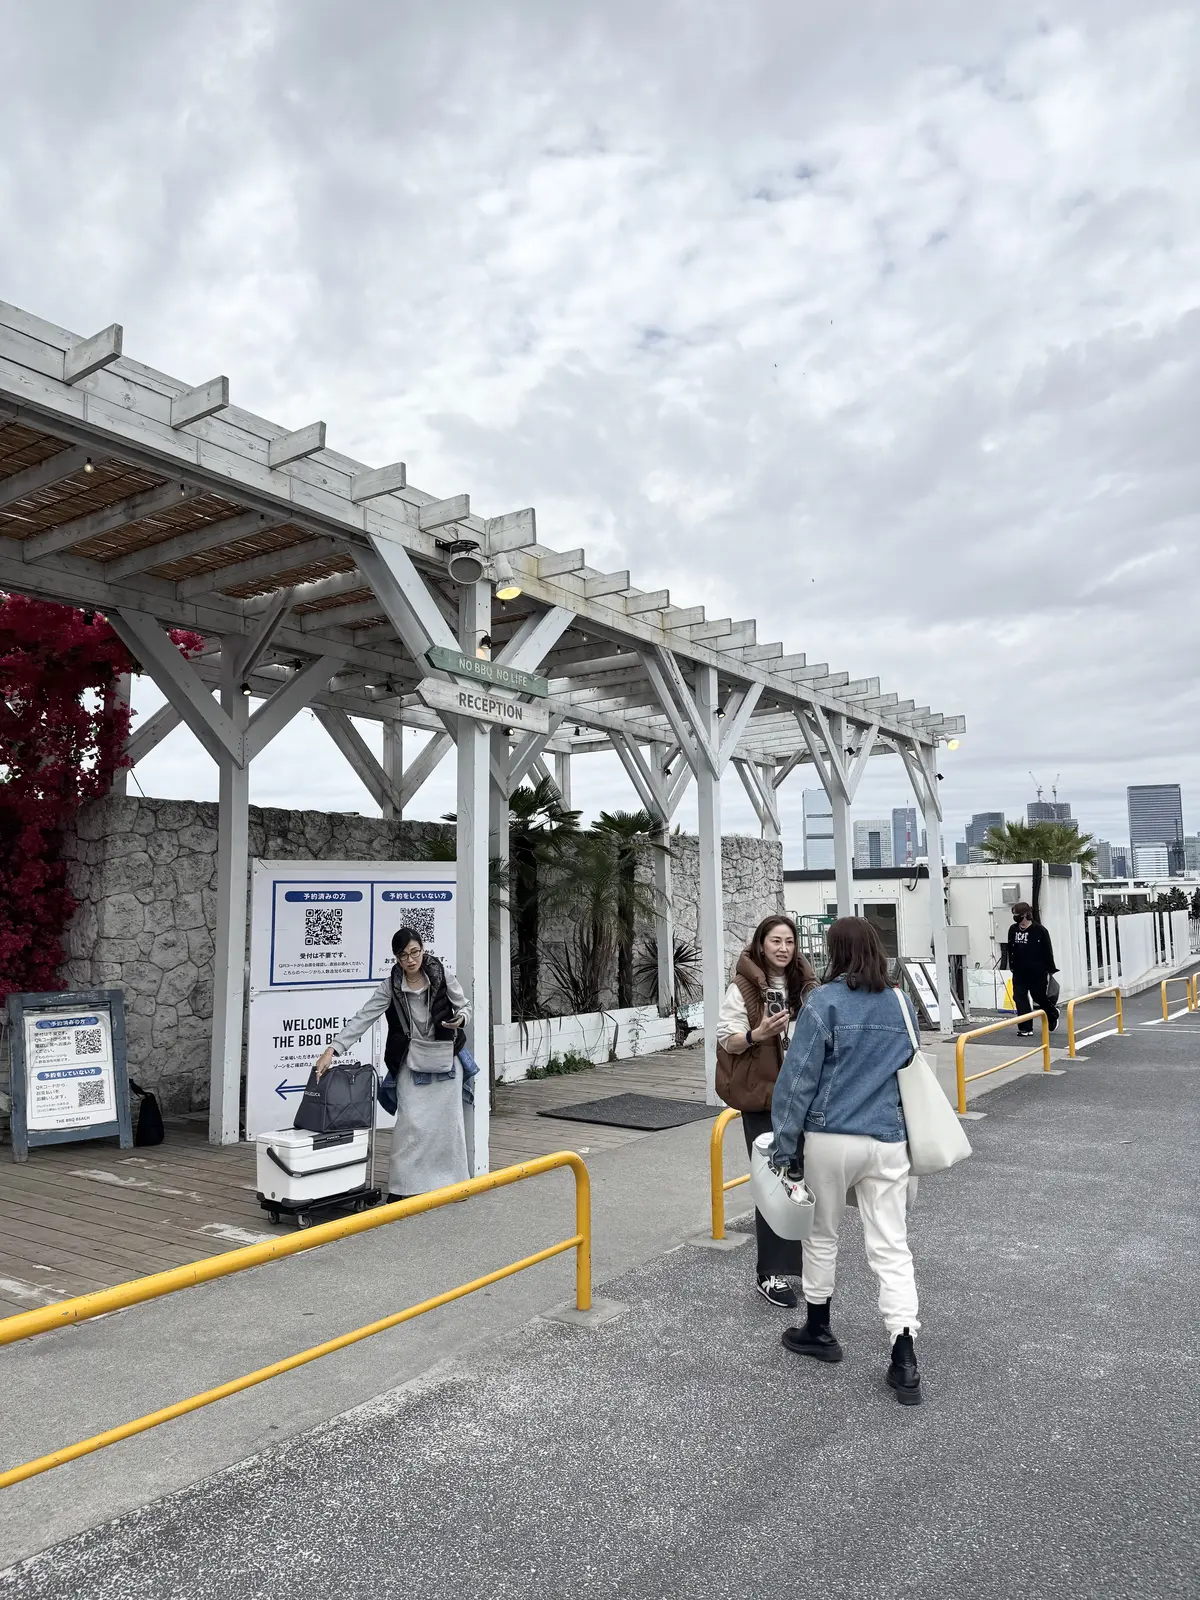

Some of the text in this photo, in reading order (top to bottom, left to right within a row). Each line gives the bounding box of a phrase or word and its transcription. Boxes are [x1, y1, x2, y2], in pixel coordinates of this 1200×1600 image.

[459, 658, 528, 686] NO BBQ NO LIFE
[459, 692, 523, 720] RECEPTION
[303, 893, 347, 901] 予約済みの方
[389, 892, 447, 900] 予約をしていない方
[299, 951, 347, 960] 受付は不要です。
[282, 1017, 339, 1031] WELCOME
[272, 1036, 295, 1048] THE
[298, 1034, 322, 1047] BBQ
[43, 1068, 96, 1079] 予約をしていない方
